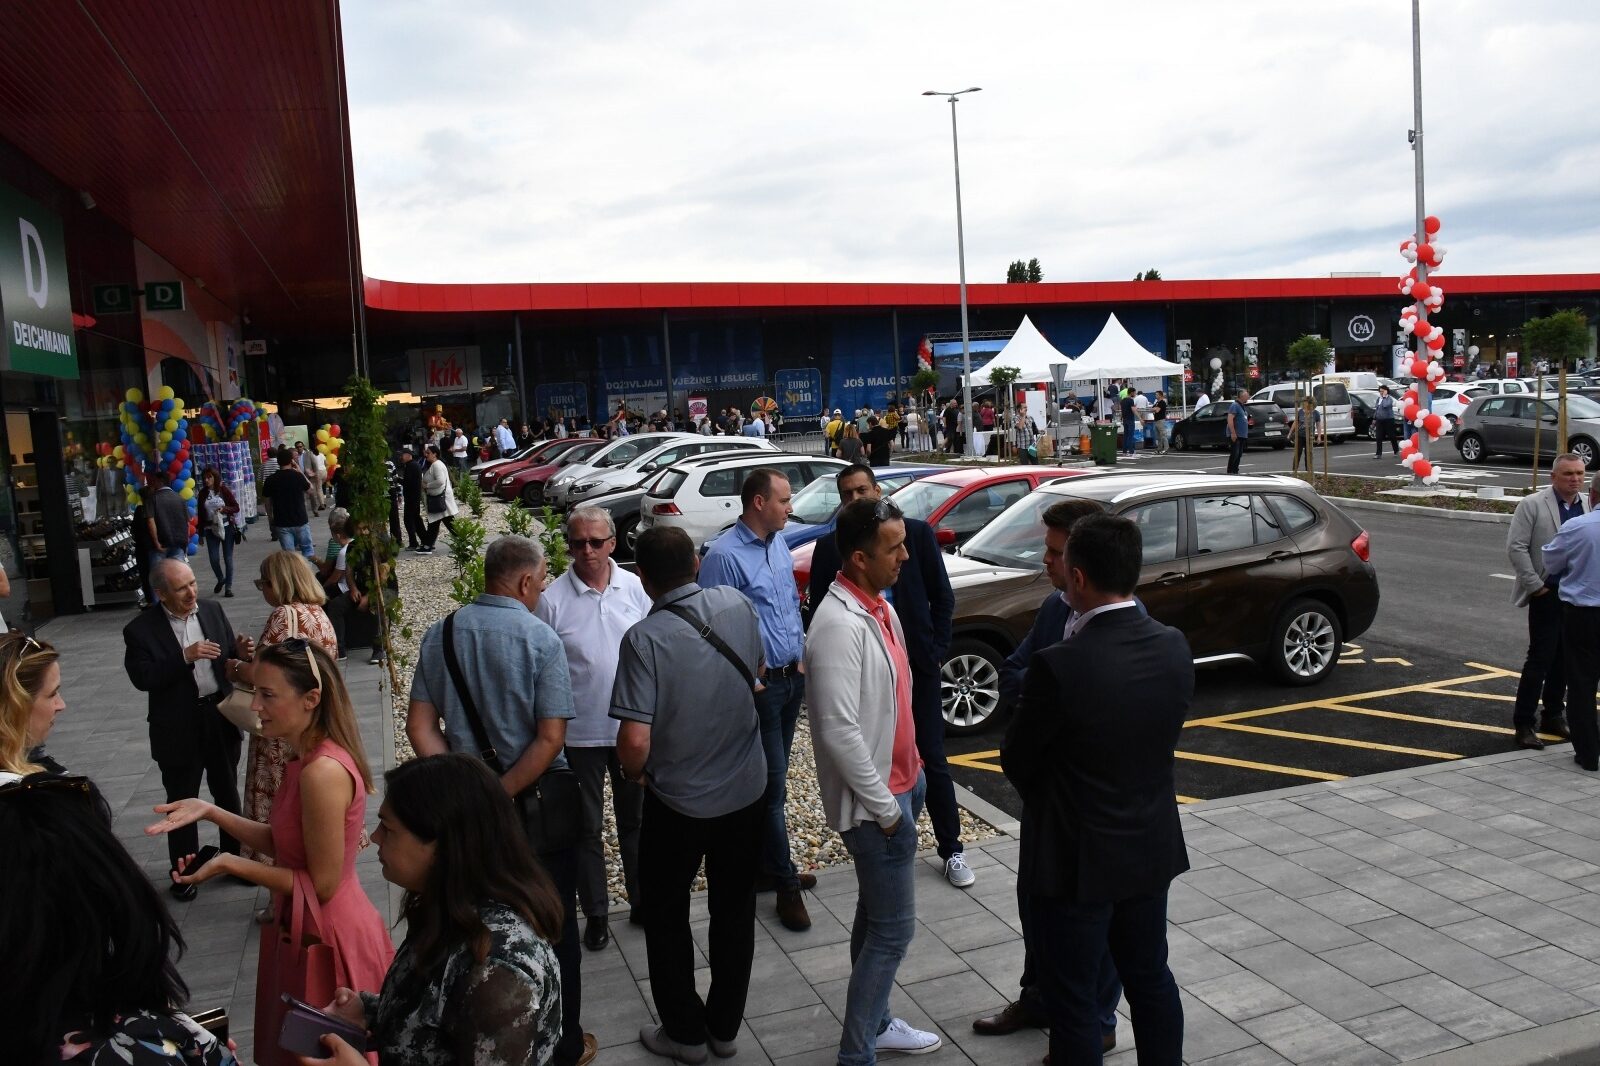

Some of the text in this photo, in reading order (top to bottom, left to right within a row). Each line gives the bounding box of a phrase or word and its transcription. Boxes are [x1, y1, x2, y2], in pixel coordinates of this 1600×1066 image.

[18, 217, 49, 309] D
[154, 285, 174, 303] D
[1352, 322, 1371, 334] C&A
[13, 320, 72, 356] DEICHMANN
[671, 375, 712, 387] VJEŽINE
[720, 373, 759, 384] USLUGE
[787, 380, 810, 390] EURO
[843, 376, 865, 388] JOŠ
[784, 389, 812, 406] Spin
